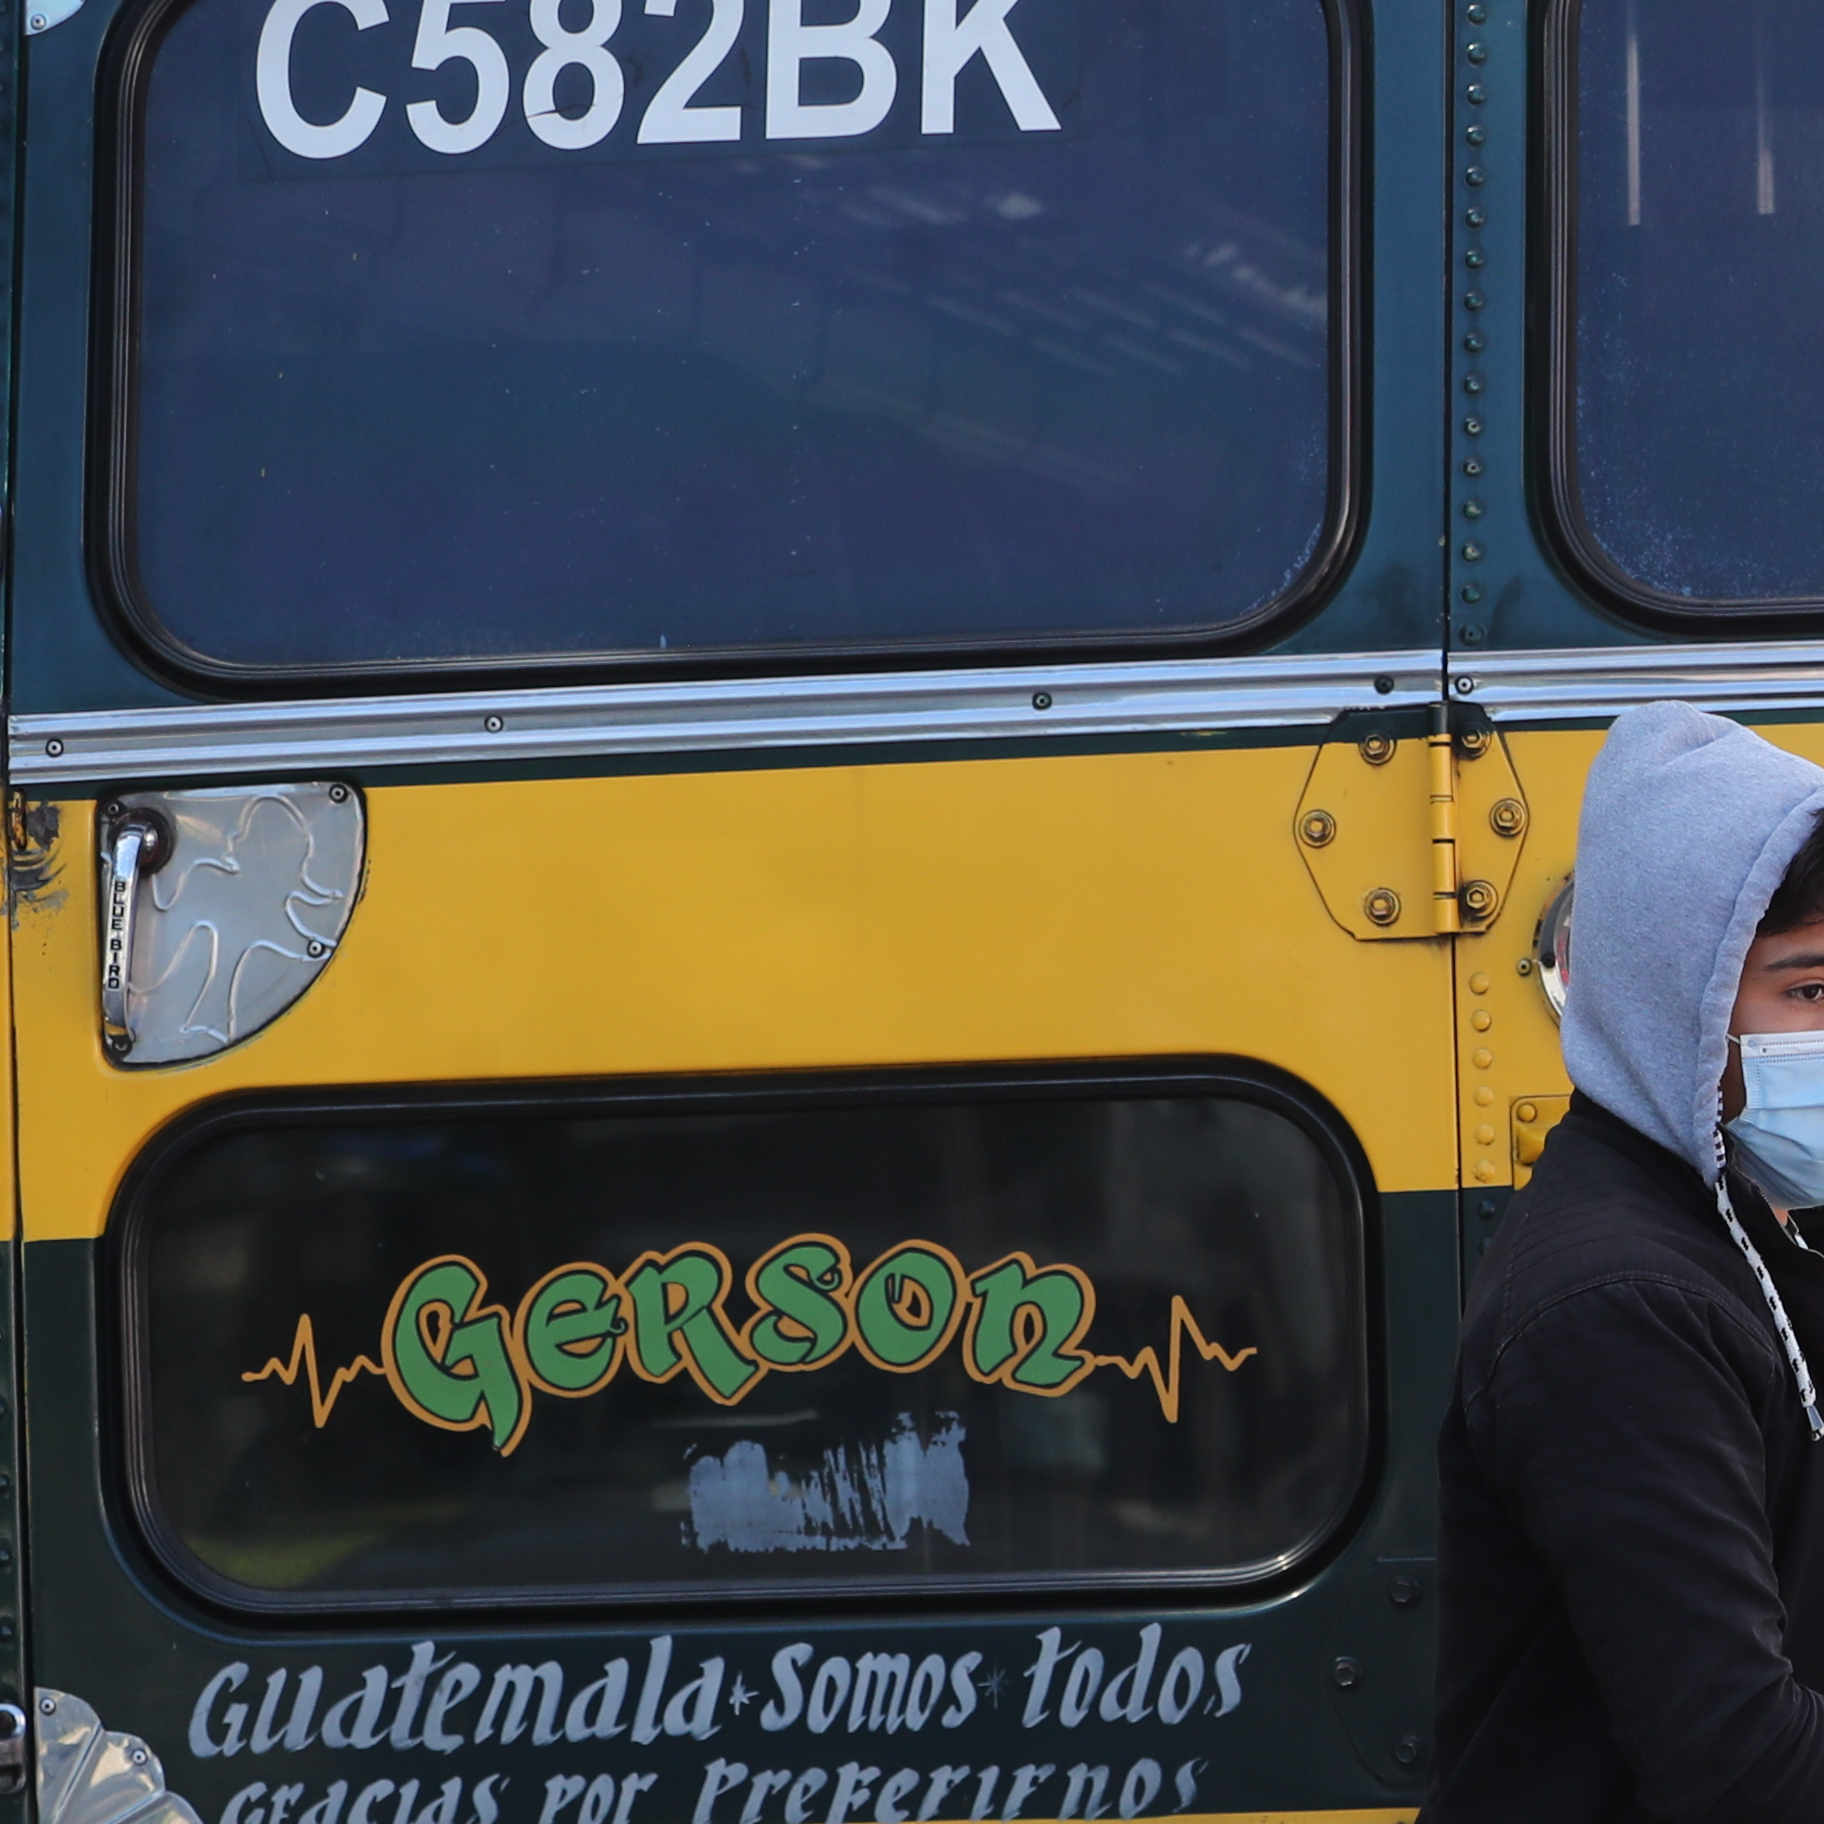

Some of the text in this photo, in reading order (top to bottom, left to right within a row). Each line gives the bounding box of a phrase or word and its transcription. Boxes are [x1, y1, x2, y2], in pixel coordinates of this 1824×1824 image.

[256, 0, 1062, 159] C582BK
[108, 881, 126, 989] BLUE BIRD
[760, 1642, 984, 1735] Somos
[1022, 1622, 1252, 1729] todos
